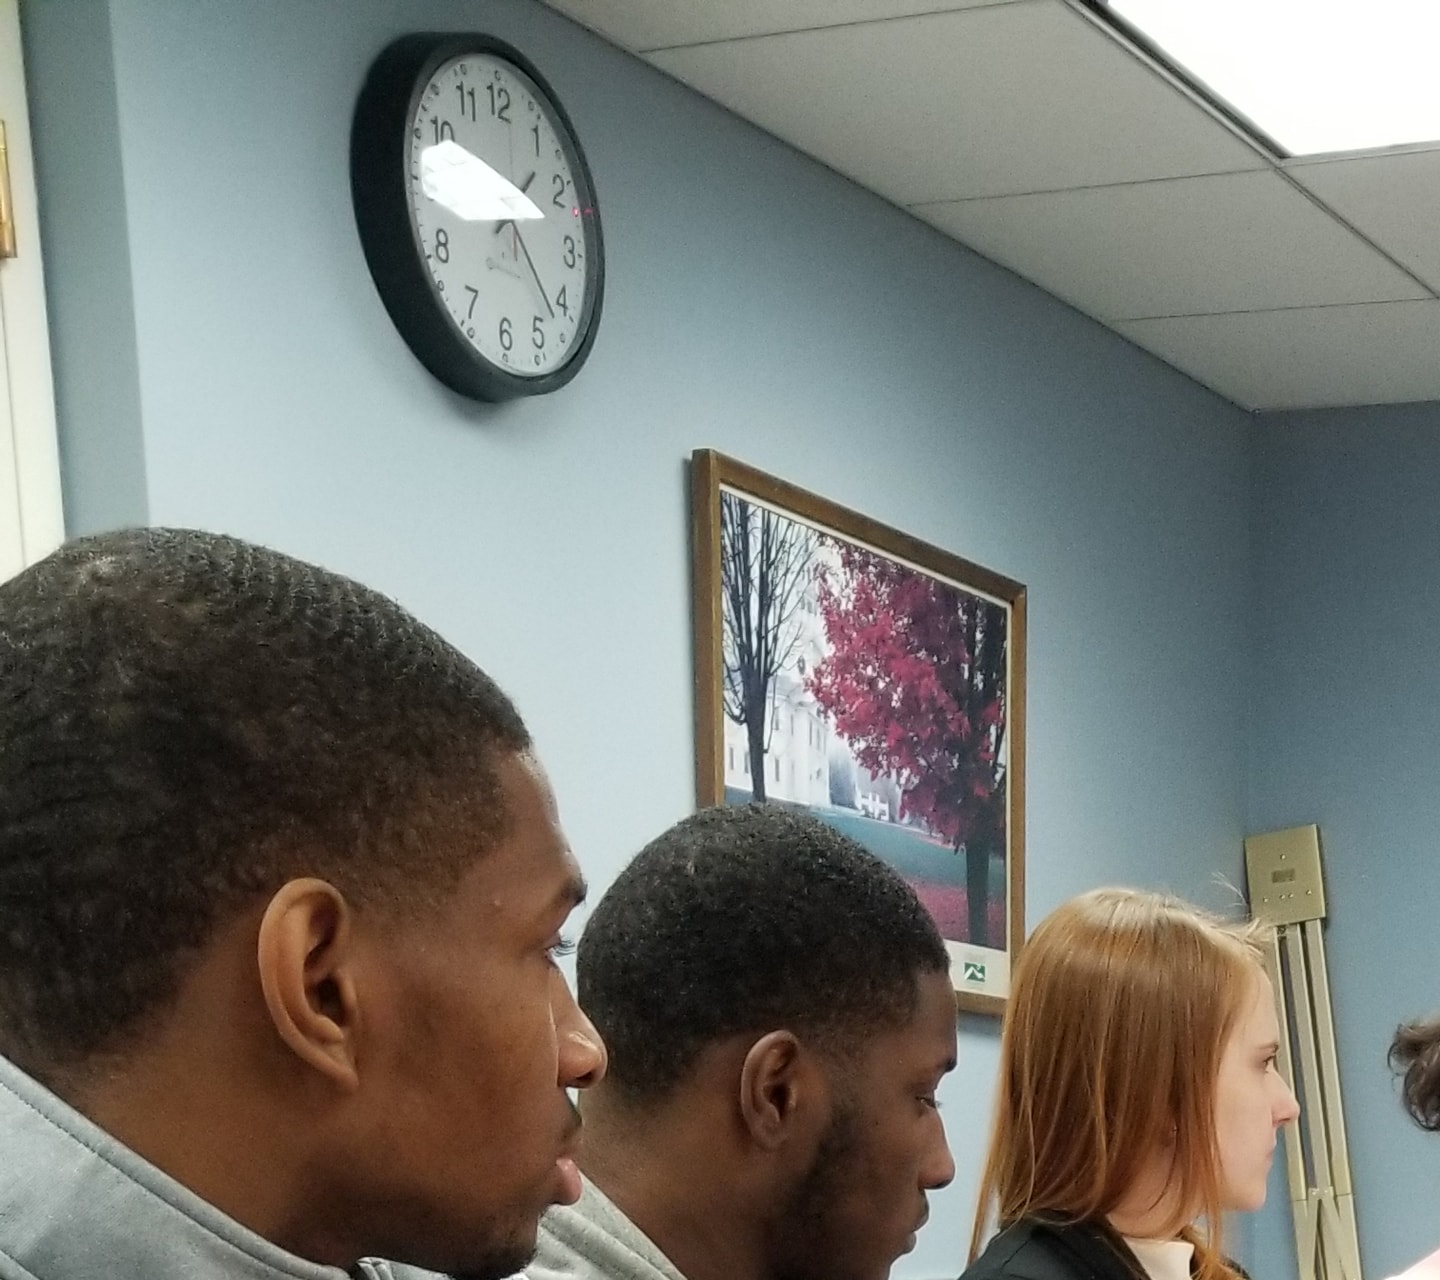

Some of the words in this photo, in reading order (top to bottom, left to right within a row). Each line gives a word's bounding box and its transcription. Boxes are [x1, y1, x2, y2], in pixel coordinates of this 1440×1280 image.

[455, 80, 476, 122] 11
[486, 82, 512, 124] 12
[552, 174, 566, 209] 2
[435, 228, 450, 263] 8
[563, 235, 576, 269] 3
[465, 284, 479, 319] 7
[556, 284, 568, 317] 4
[499, 316, 513, 351] 6
[532, 315, 545, 349] 5
